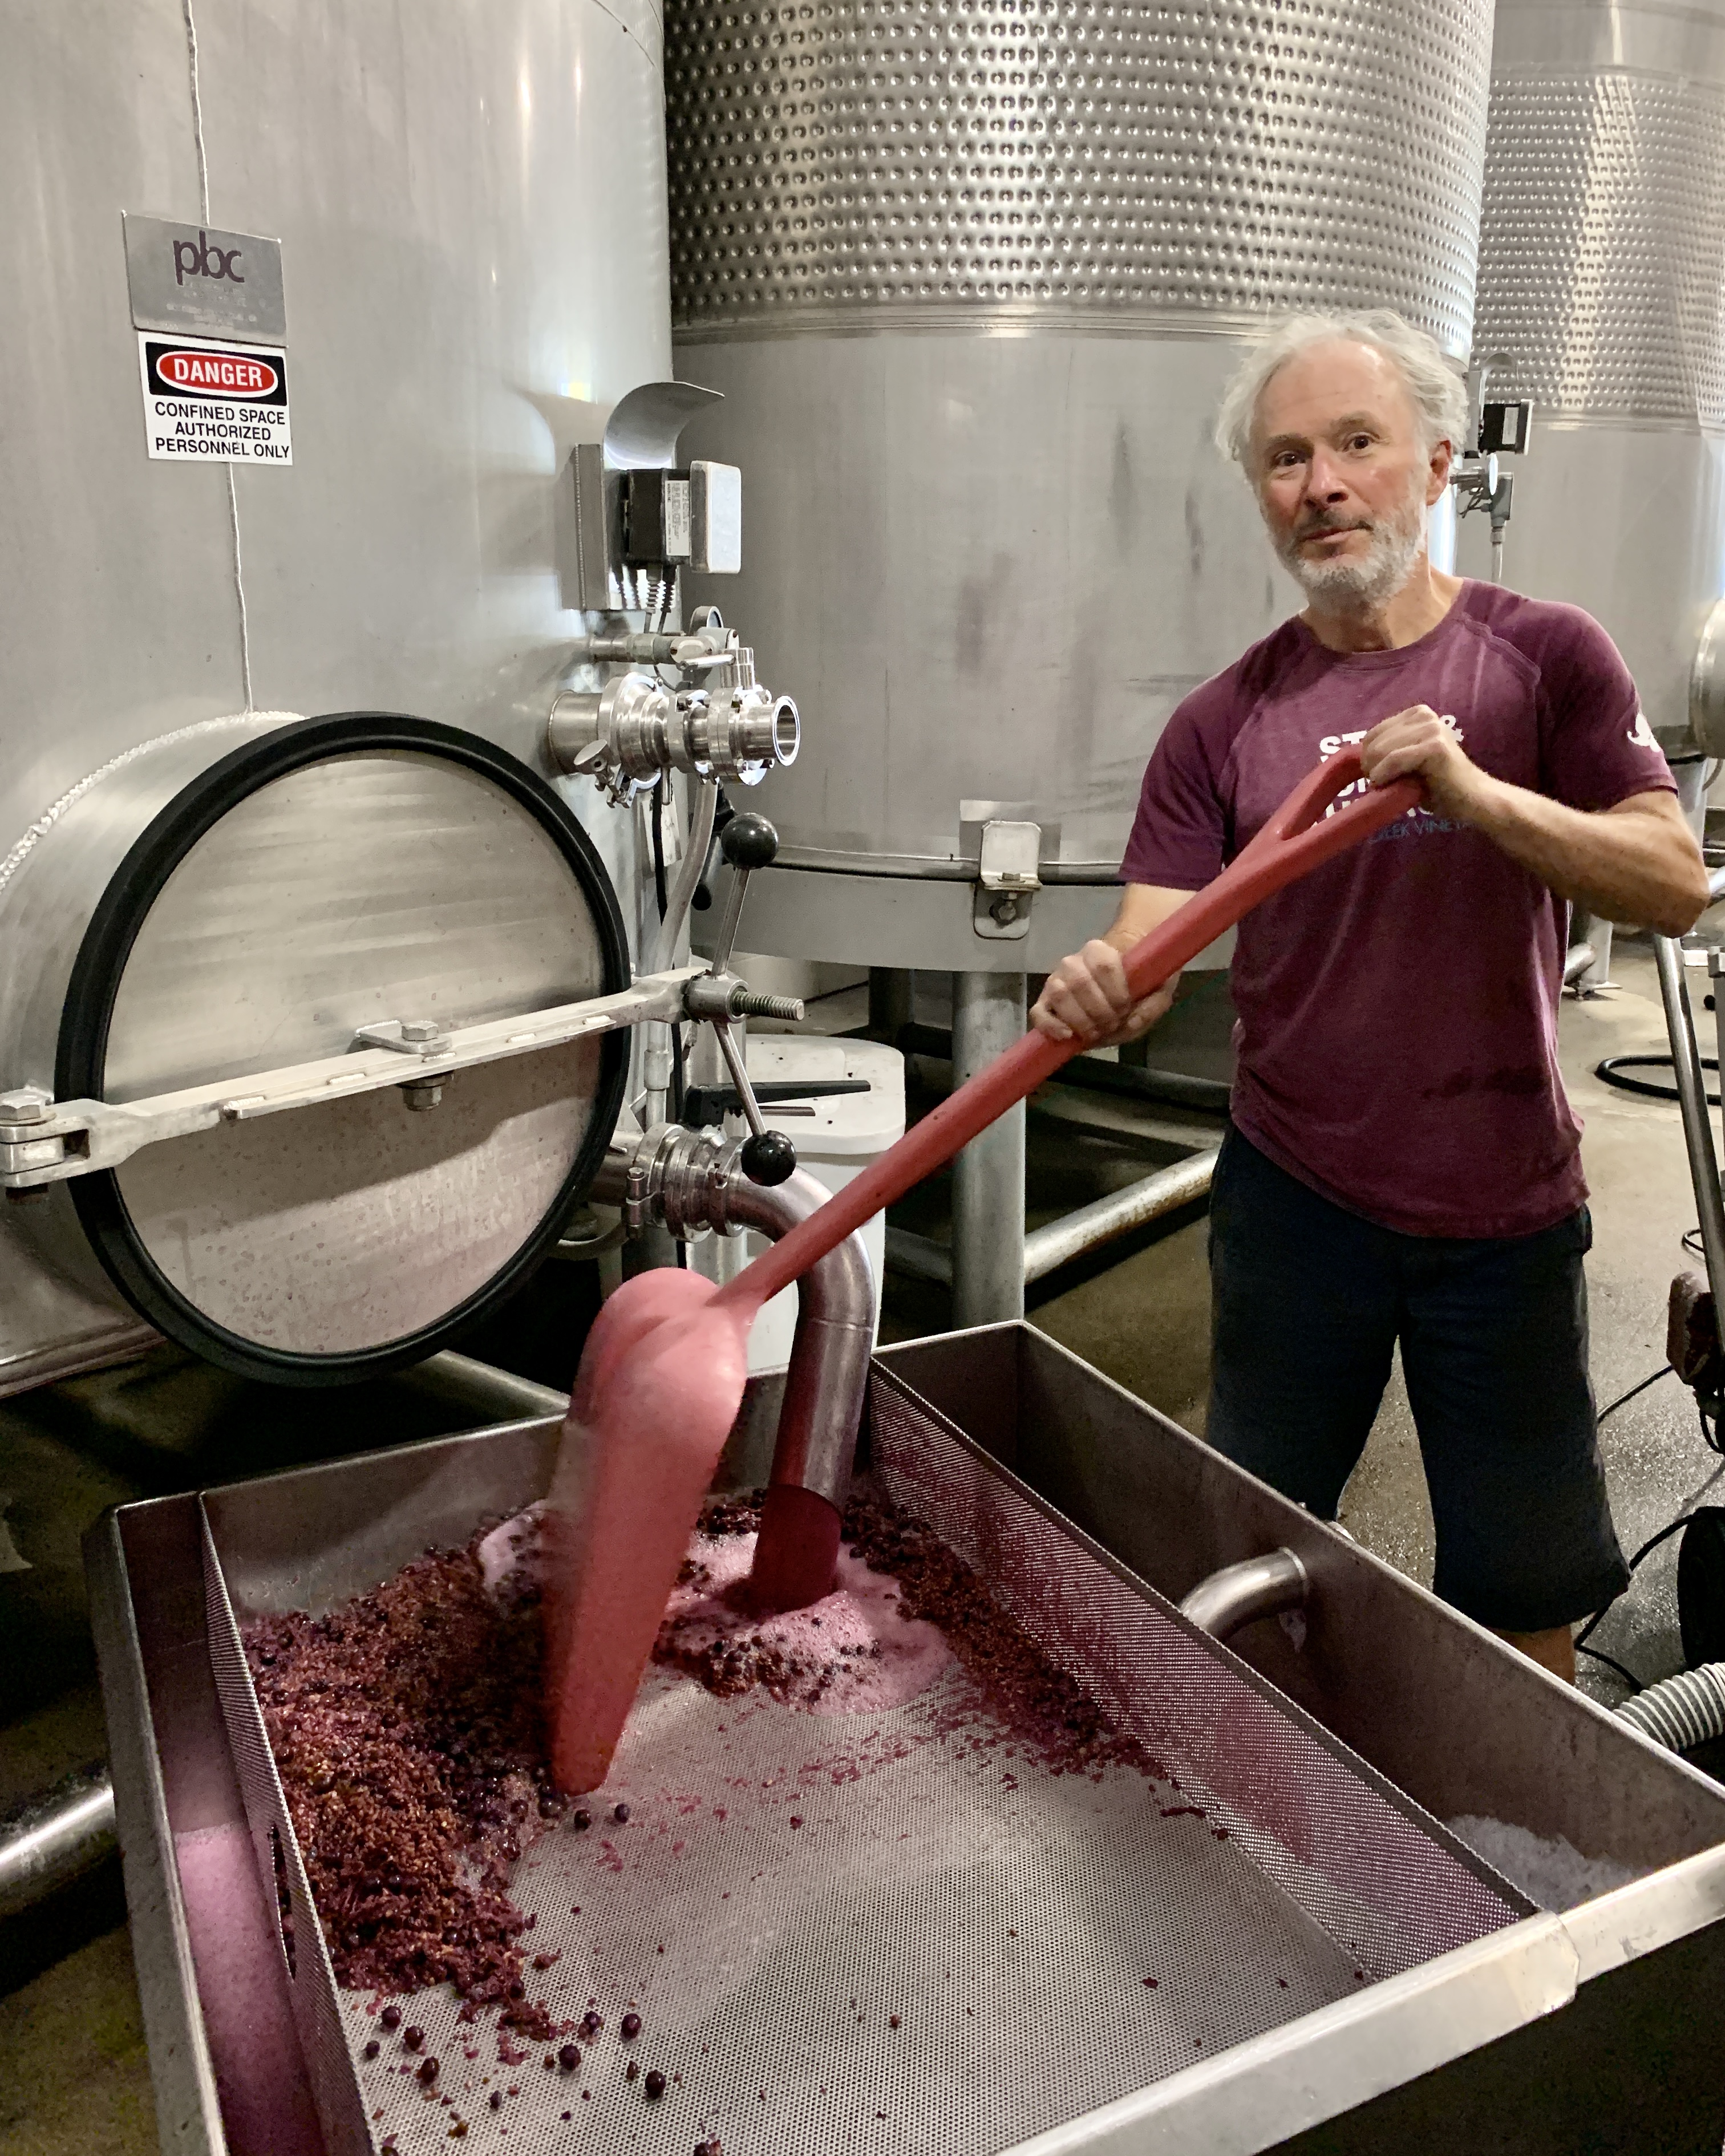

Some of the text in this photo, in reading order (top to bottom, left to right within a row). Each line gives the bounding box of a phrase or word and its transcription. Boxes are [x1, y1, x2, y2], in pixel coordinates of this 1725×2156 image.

[173, 230, 245, 286] pbc
[173, 358, 263, 388] DANGER
[155, 402, 285, 425] CONFINED SPACE
[175, 422, 271, 440] AUTHORIZED
[156, 437, 290, 459] PERSONNEL ONLY
